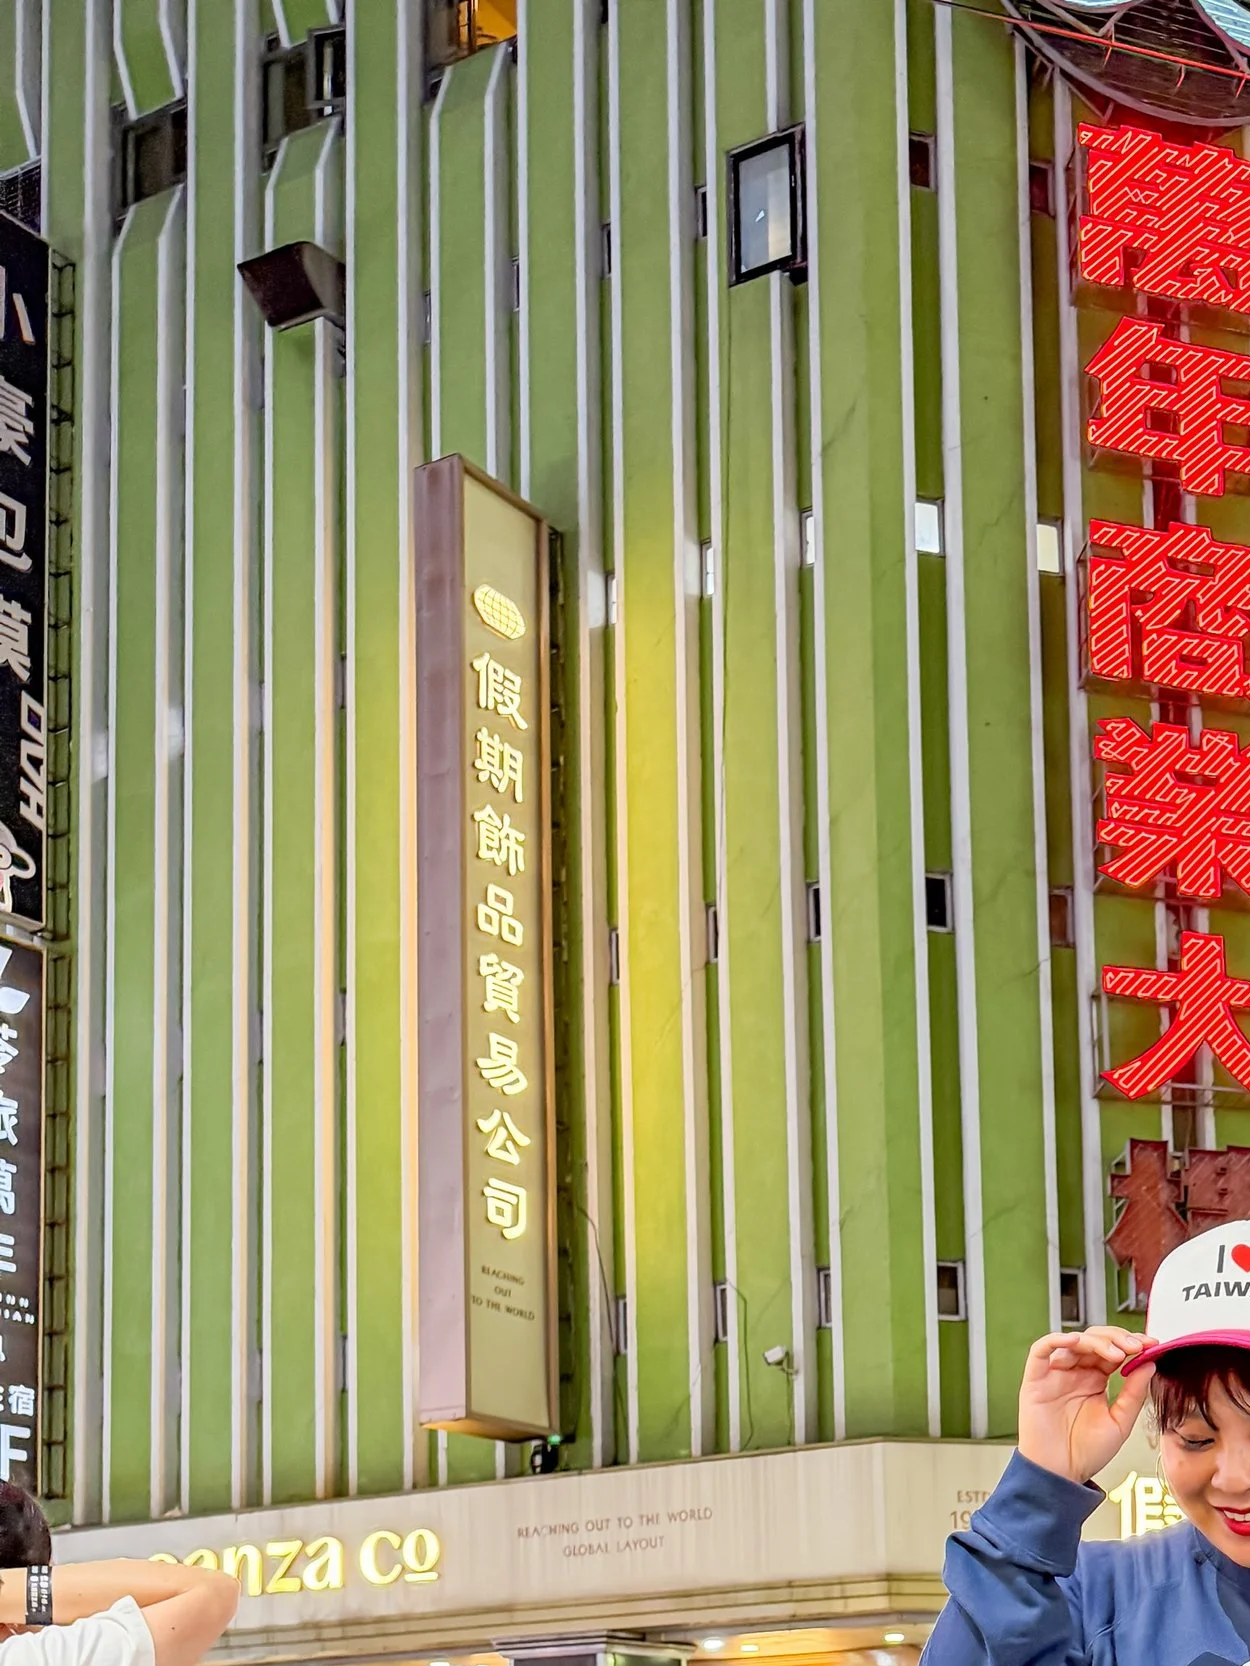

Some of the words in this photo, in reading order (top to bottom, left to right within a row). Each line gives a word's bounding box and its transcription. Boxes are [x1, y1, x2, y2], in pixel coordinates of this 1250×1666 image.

[472, 650, 531, 1242] 假期飾品貿易公司
[617, 1516, 633, 1529] TO
